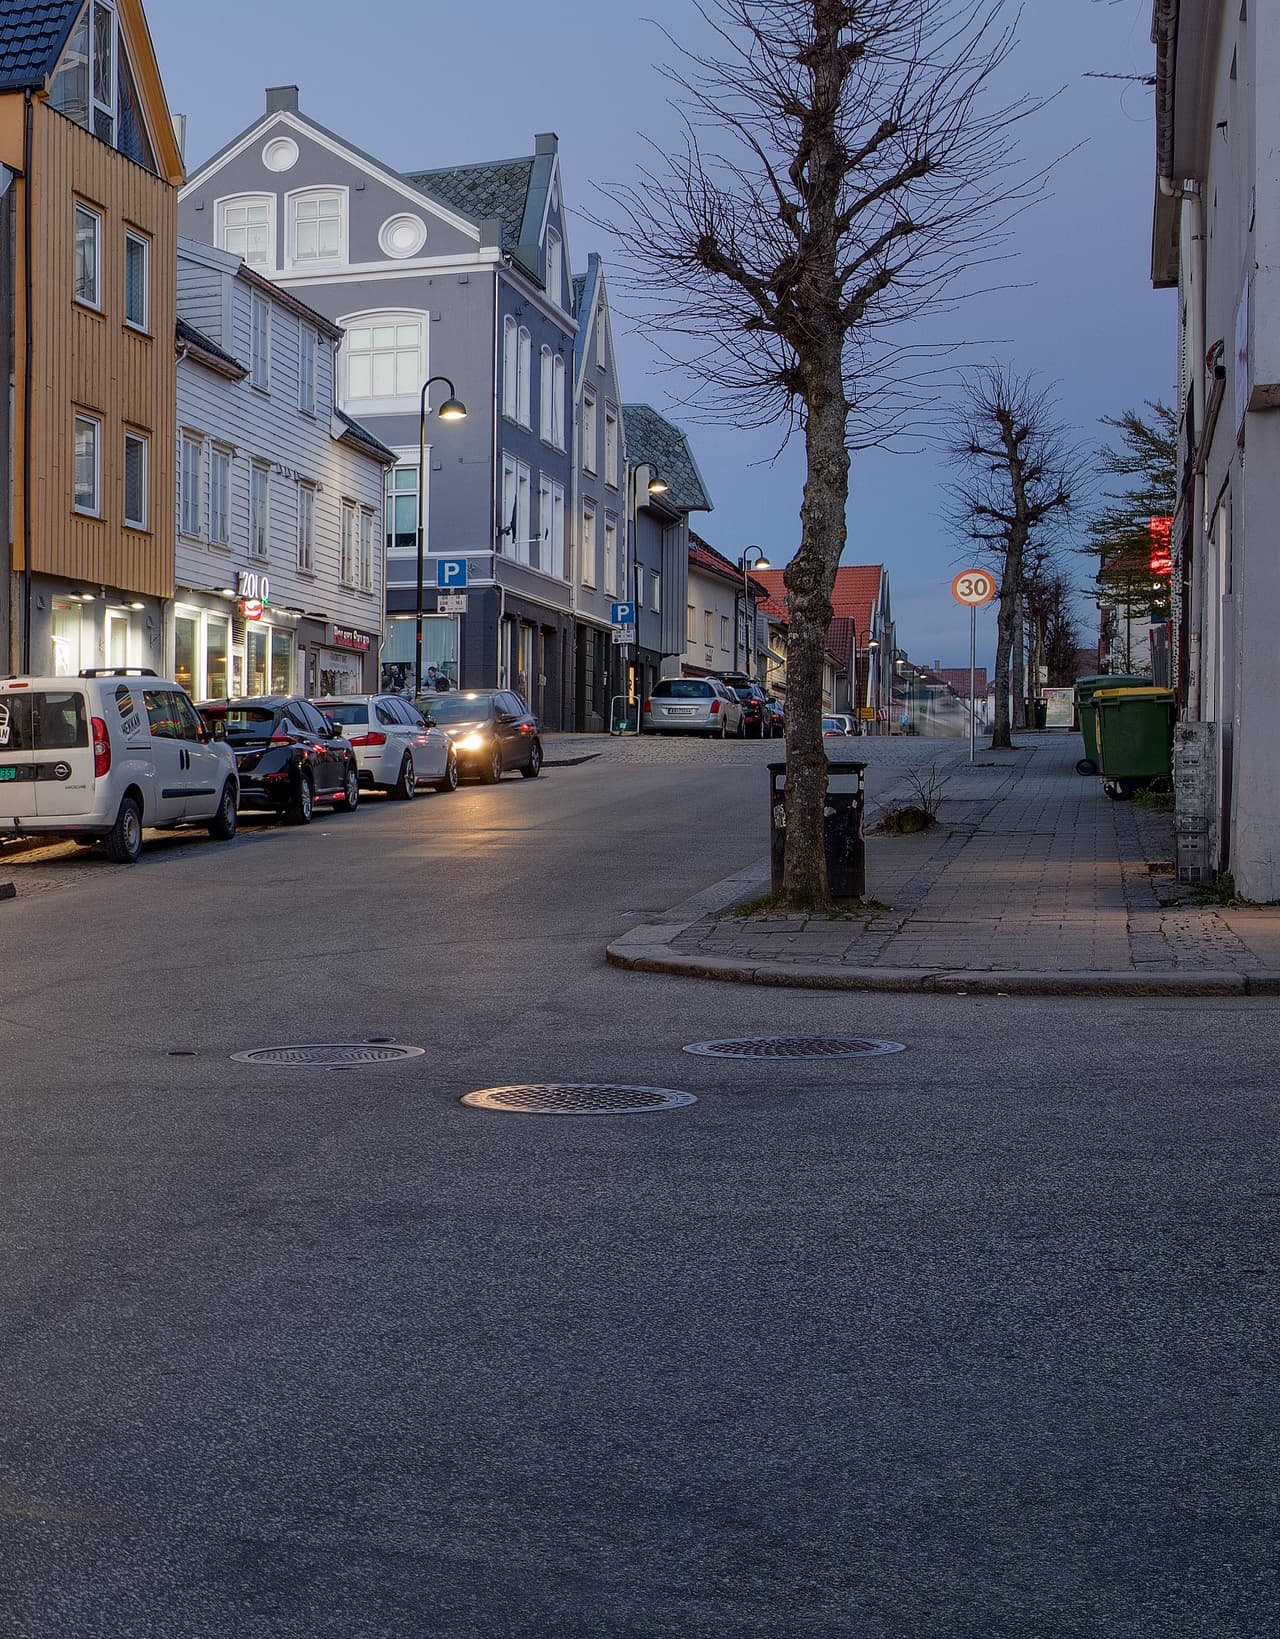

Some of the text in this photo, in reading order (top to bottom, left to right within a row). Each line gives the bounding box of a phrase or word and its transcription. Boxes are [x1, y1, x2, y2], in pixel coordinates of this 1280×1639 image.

[444, 562, 460, 584] P
[960, 578, 988, 597] 30
[617, 605, 630, 622] P
